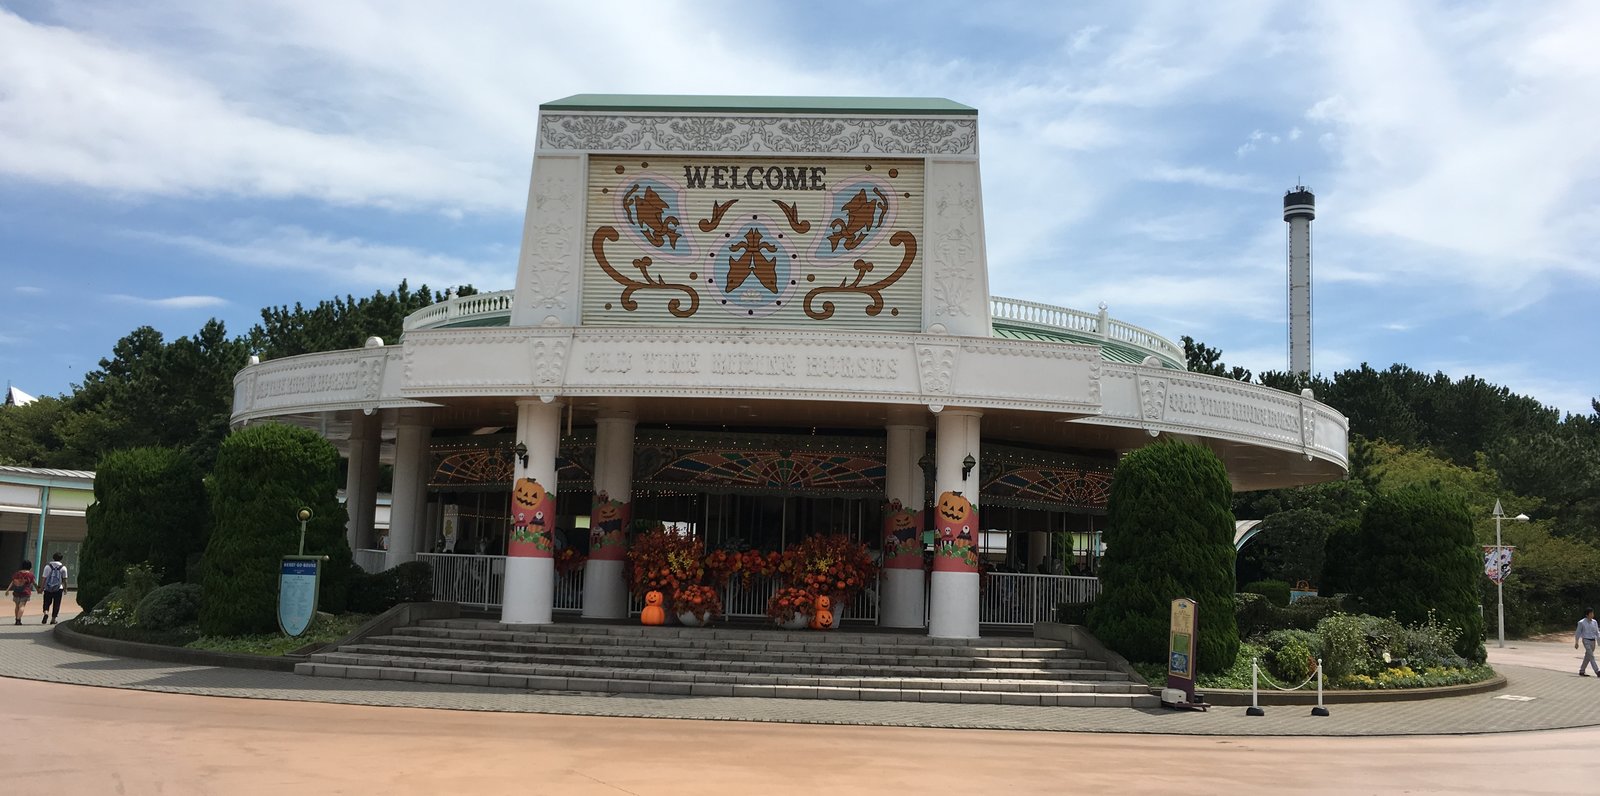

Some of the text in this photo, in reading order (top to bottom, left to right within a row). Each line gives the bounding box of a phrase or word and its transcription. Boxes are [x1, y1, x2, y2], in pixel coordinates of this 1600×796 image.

[683, 165, 827, 191] WELCOME
[584, 352, 898, 380] OLD TIME RIDING HORSES
